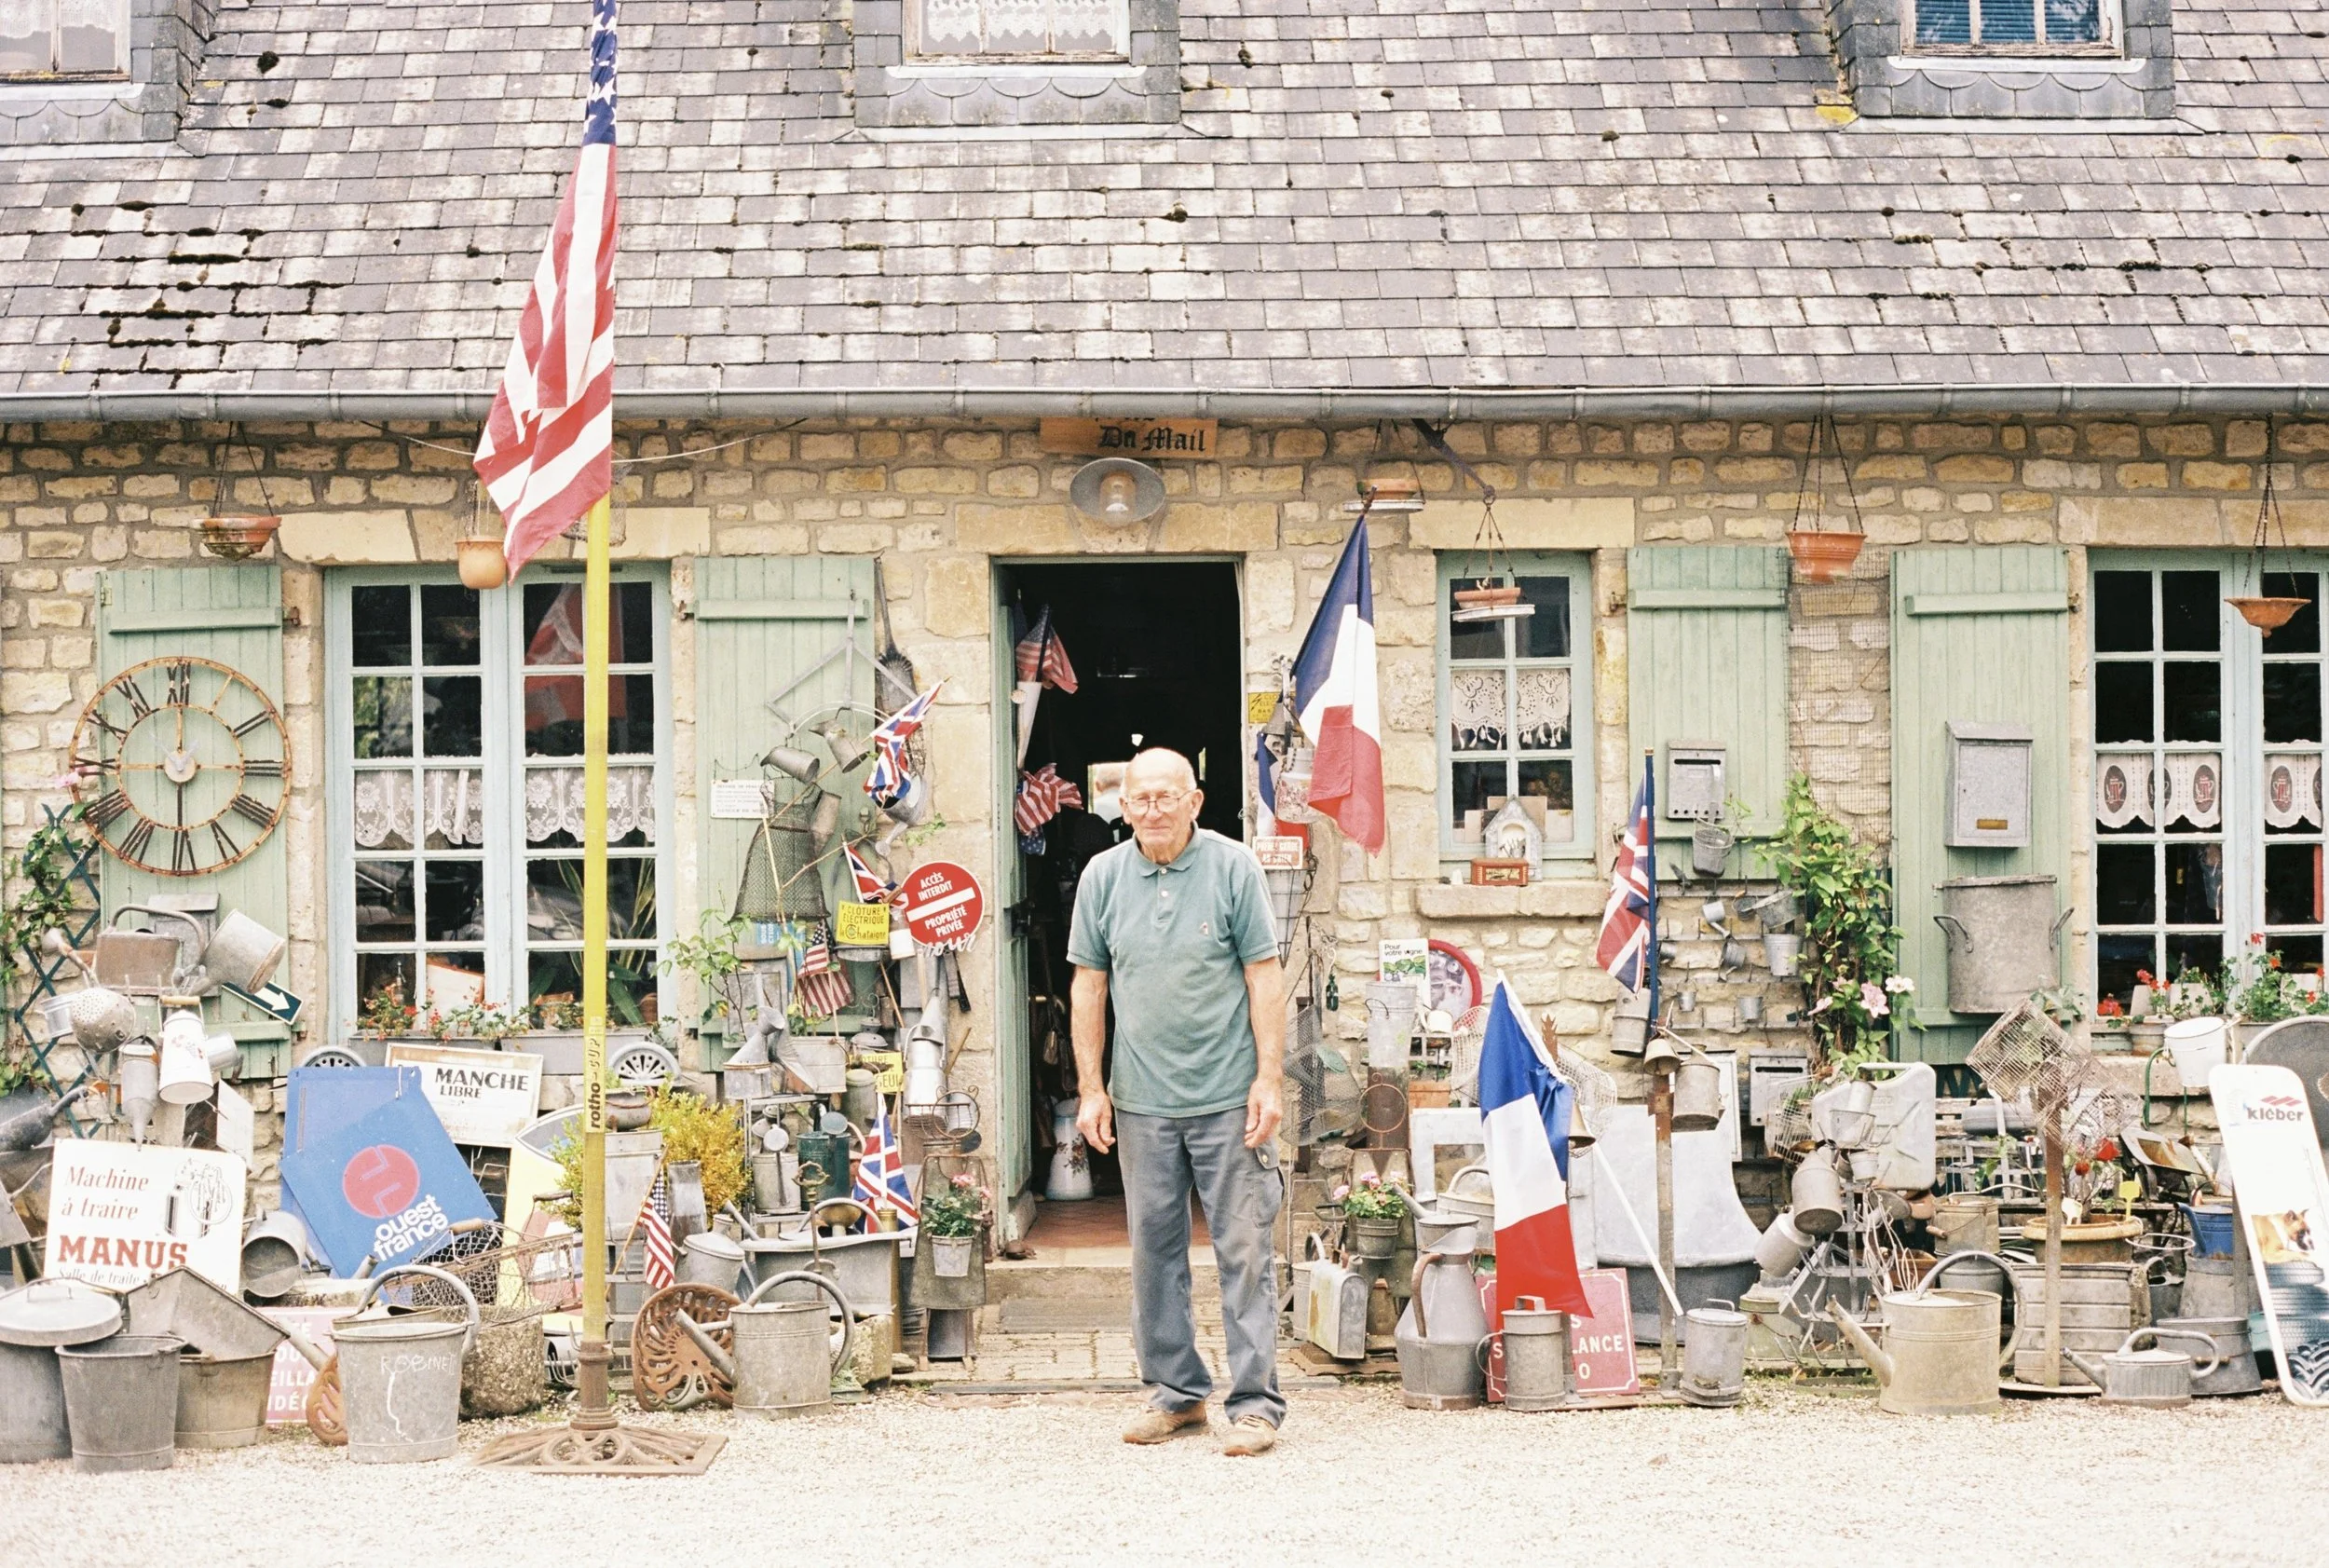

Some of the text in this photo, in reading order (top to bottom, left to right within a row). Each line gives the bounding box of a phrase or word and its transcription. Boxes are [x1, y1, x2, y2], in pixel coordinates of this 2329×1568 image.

[1141, 427, 1206, 451] Mail
[918, 880, 953, 901] INTERDIT
[919, 872, 945, 889] ACCÈS
[924, 905, 967, 930] PROPRIÉTÉ
[935, 919, 965, 937] PRIVÉE
[435, 1068, 529, 1092] MANCHE
[440, 1084, 482, 1099] LIBRE
[66, 1166, 149, 1192] Machine
[61, 1197, 139, 1220] à traire
[375, 1194, 442, 1242] ouest
[374, 1212, 448, 1261] france
[58, 1234, 188, 1271] MANUS
[90, 1269, 104, 1284] de
